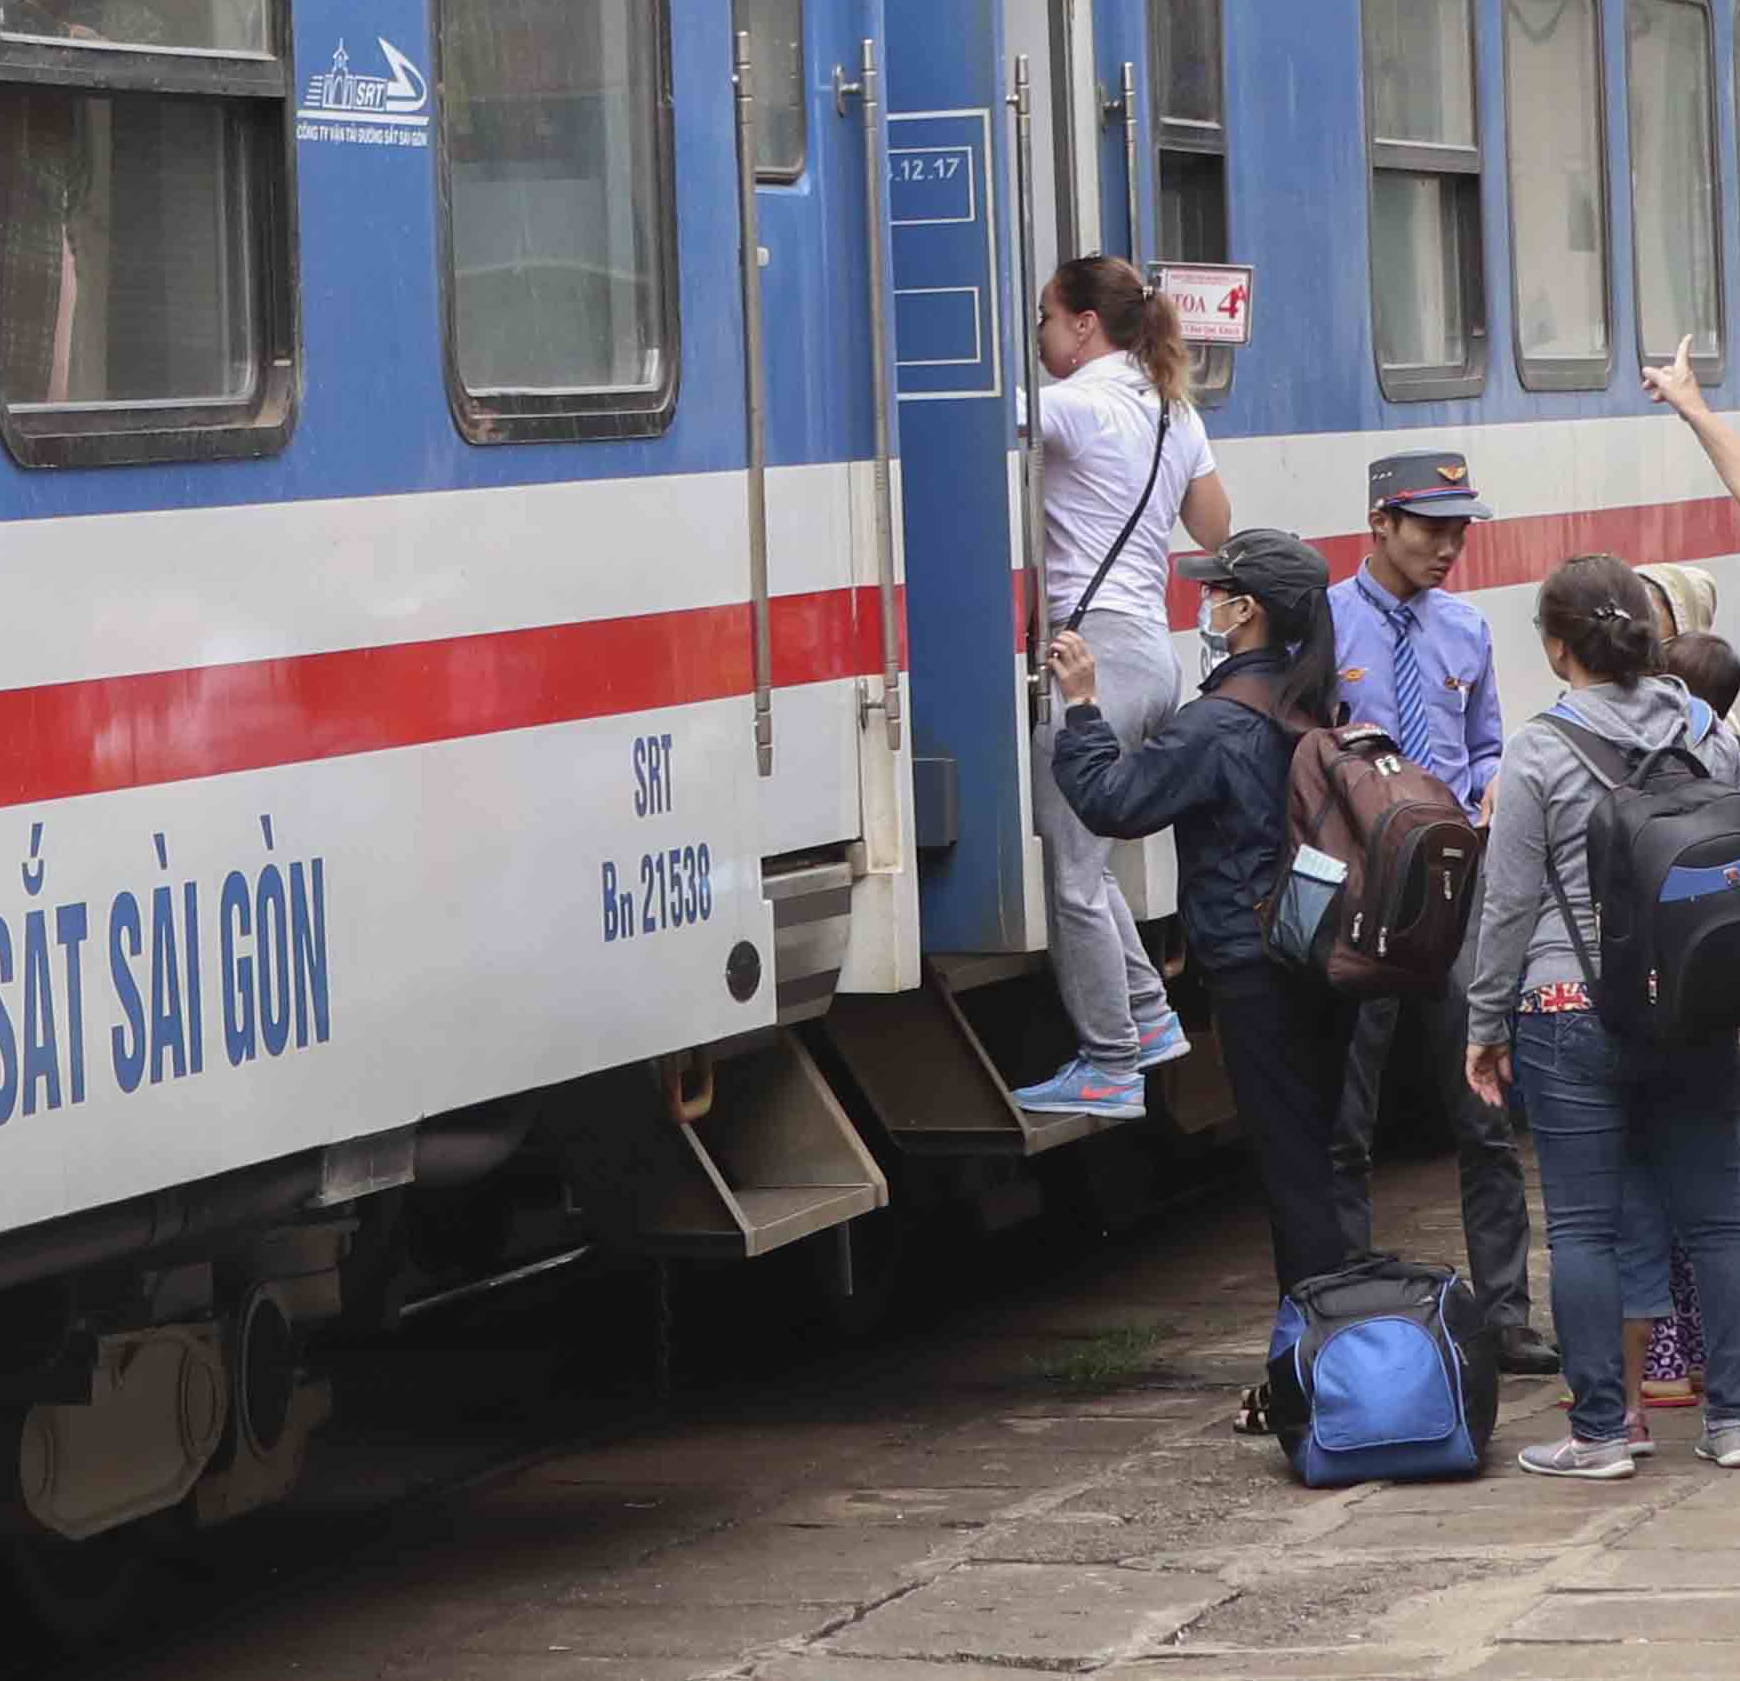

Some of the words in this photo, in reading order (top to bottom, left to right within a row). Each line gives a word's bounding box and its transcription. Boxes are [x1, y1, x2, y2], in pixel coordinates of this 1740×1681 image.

[356, 81, 385, 106] SRT
[1172, 293, 1206, 314] TOA
[632, 732, 674, 818] SRT
[601, 861, 635, 943] Bn
[640, 842, 712, 935] 21538
[109, 829, 205, 1094] SÀI
[219, 815, 331, 1066] GÒN
